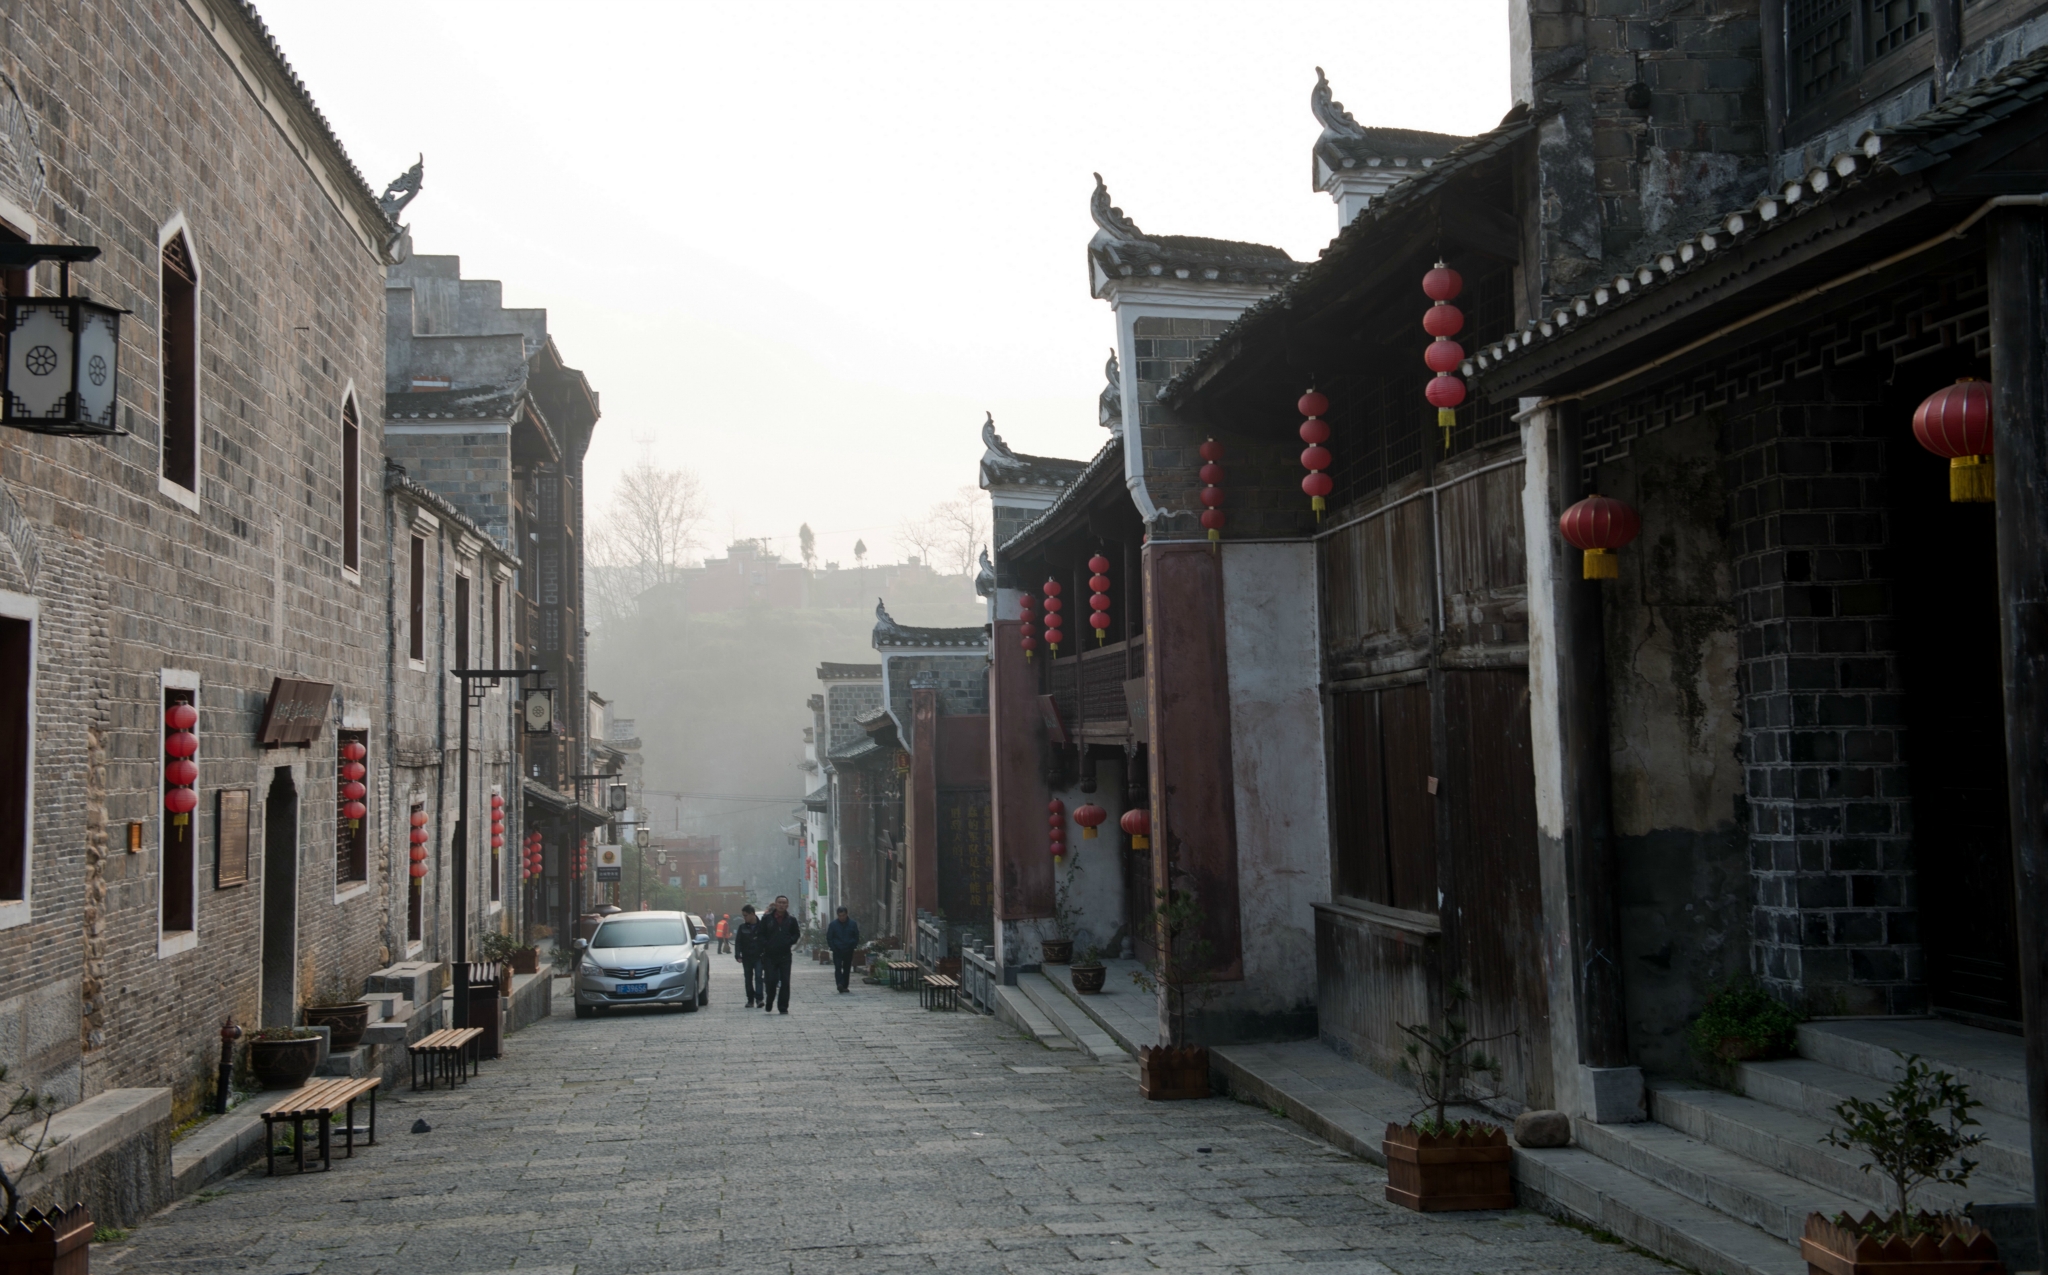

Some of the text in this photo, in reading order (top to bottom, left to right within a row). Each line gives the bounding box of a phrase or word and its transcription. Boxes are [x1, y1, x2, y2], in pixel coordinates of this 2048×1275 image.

[967, 805, 982, 906] 蠢的军队是不能战
[626, 984, 647, 993] 39656
